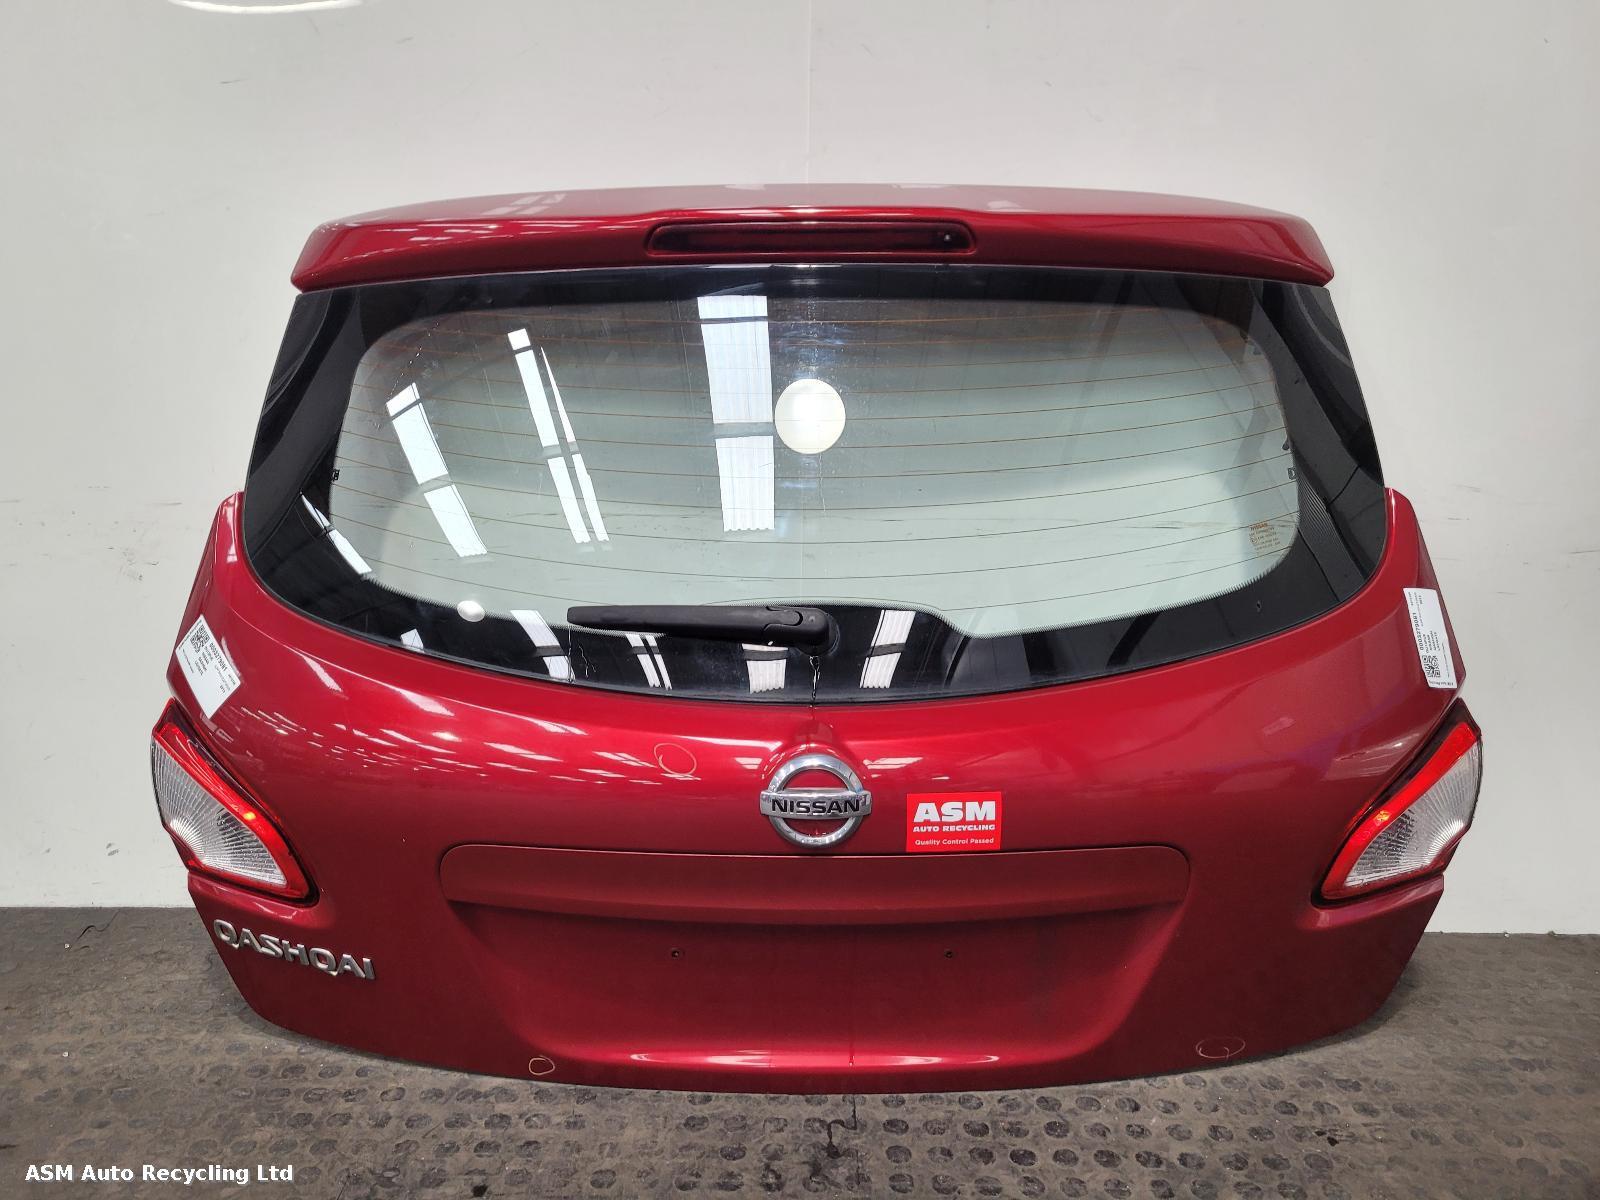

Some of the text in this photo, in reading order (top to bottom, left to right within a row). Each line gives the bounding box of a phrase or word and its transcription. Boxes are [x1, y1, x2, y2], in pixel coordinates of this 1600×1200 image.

[771, 799, 860, 814] NISSAN
[913, 801, 996, 823] ASM
[913, 824, 996, 833] AUTO RECYCLING
[915, 838, 941, 846] Quality
[213, 919, 376, 980] QASHQAI
